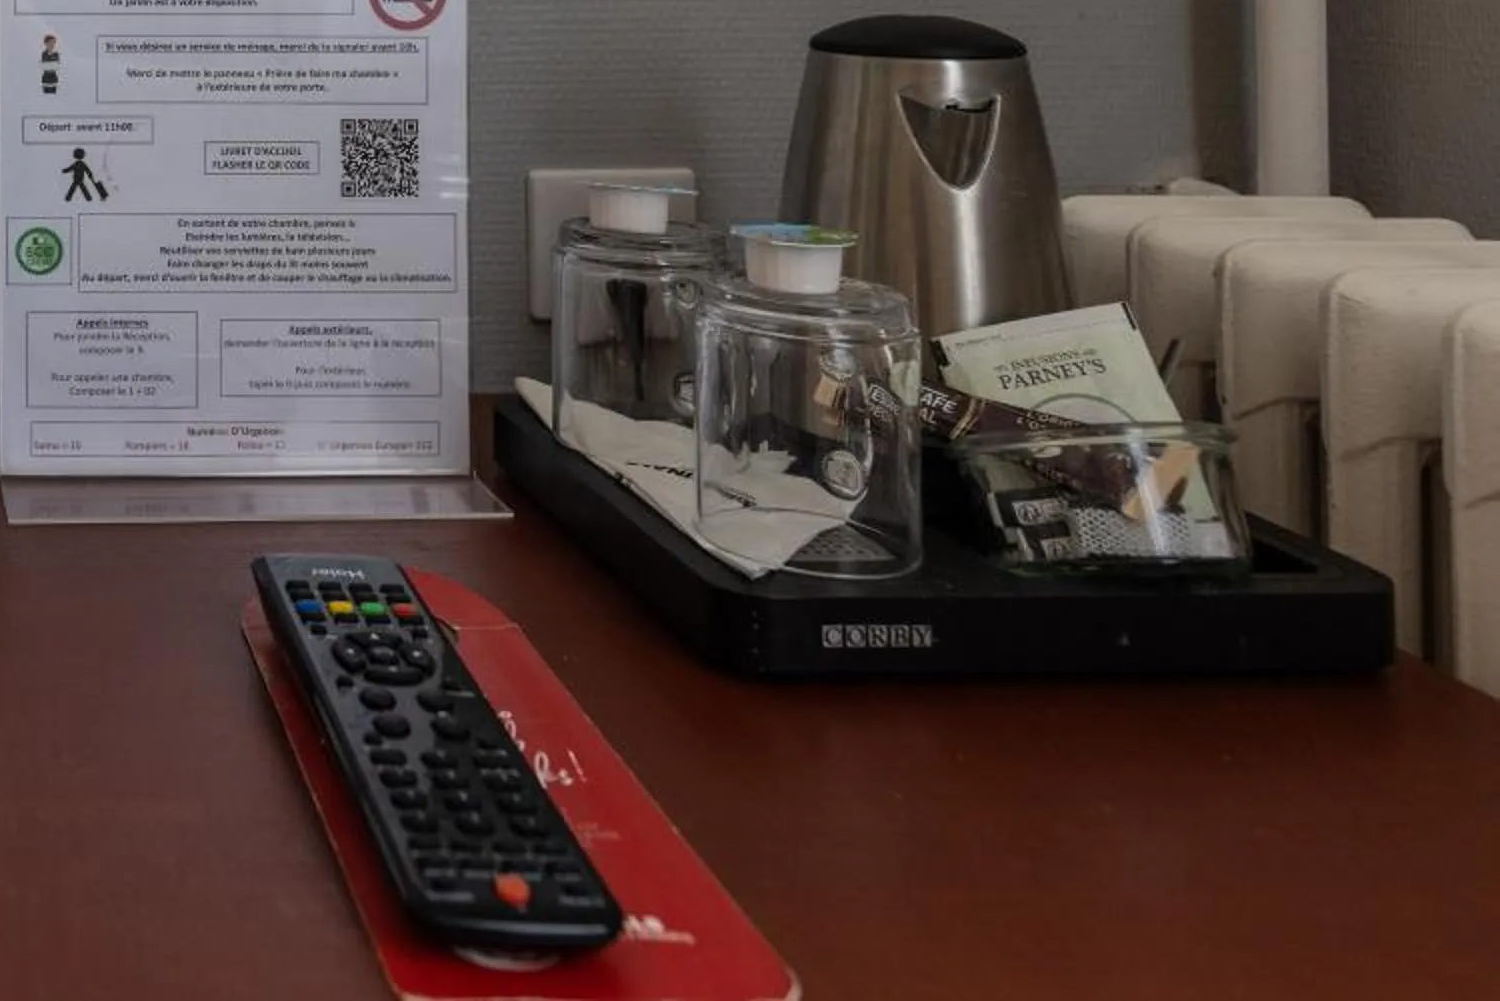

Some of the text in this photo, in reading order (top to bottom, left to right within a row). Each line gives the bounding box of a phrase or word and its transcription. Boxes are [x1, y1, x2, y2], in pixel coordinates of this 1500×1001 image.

[116, 42, 137, 53] vous
[155, 68, 167, 79] de
[213, 68, 255, 79] panneau
[259, 82, 271, 93] de
[273, 82, 298, 93] votre
[284, 160, 310, 170] CODE
[227, 219, 239, 229] de
[226, 231, 239, 242] les
[998, 357, 1107, 391] PARNEY'S
